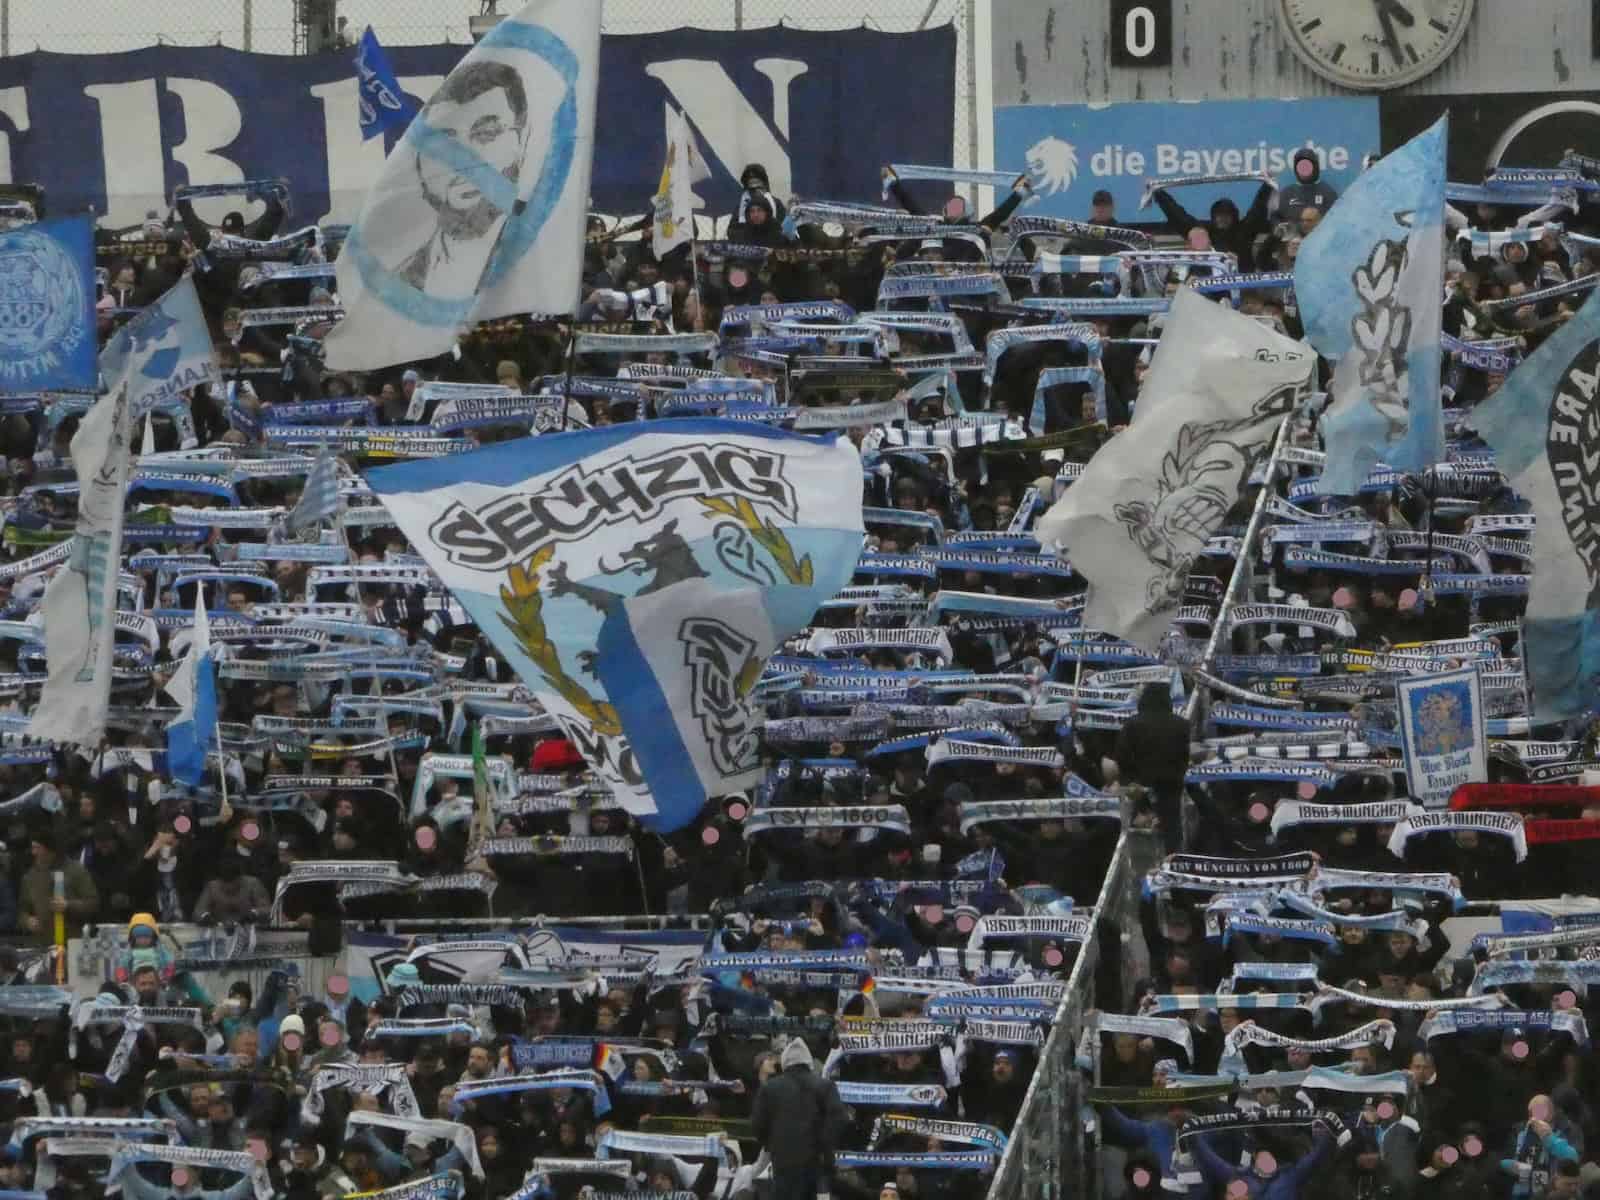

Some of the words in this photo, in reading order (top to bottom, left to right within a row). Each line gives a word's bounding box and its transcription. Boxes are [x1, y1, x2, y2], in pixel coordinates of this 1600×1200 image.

[1125, 7, 1156, 57] 0
[1090, 144, 1145, 175] die
[430, 446, 792, 570] SECHZIG
[766, 810, 808, 824] TSV
[1299, 805, 1330, 819] 1860
[1407, 813, 1441, 831] 1860
[985, 918, 1016, 932] 1860
